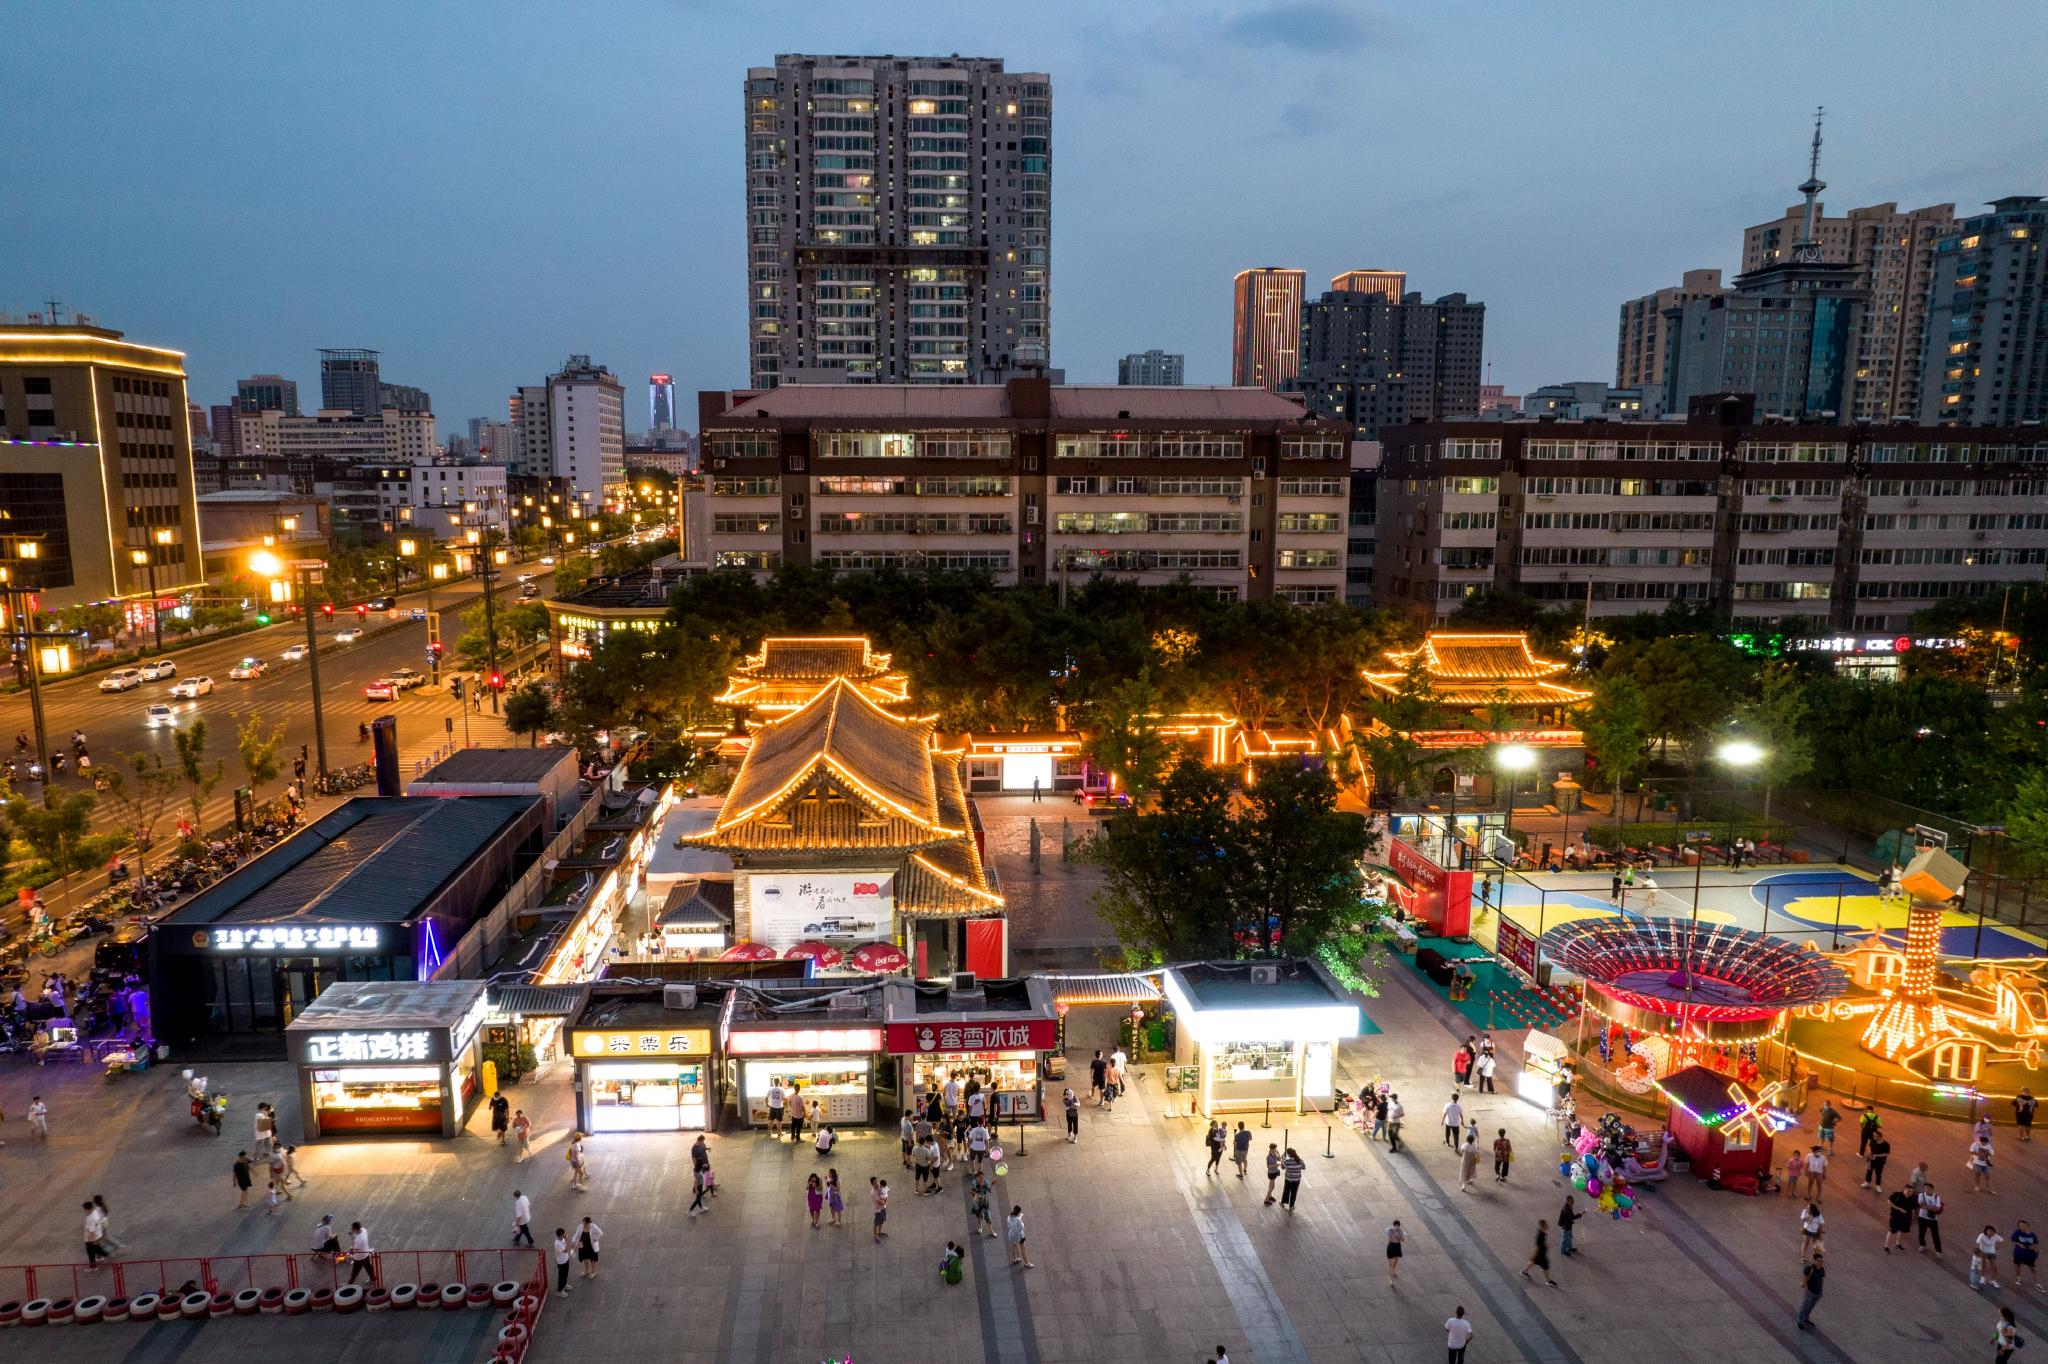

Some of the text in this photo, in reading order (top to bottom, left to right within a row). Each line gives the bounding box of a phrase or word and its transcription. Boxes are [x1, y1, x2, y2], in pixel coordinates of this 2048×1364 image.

[1866, 639, 1893, 650] ICBC
[308, 1031, 429, 1061] 正新鸡排
[940, 1025, 1030, 1049] 蜜雪冰城
